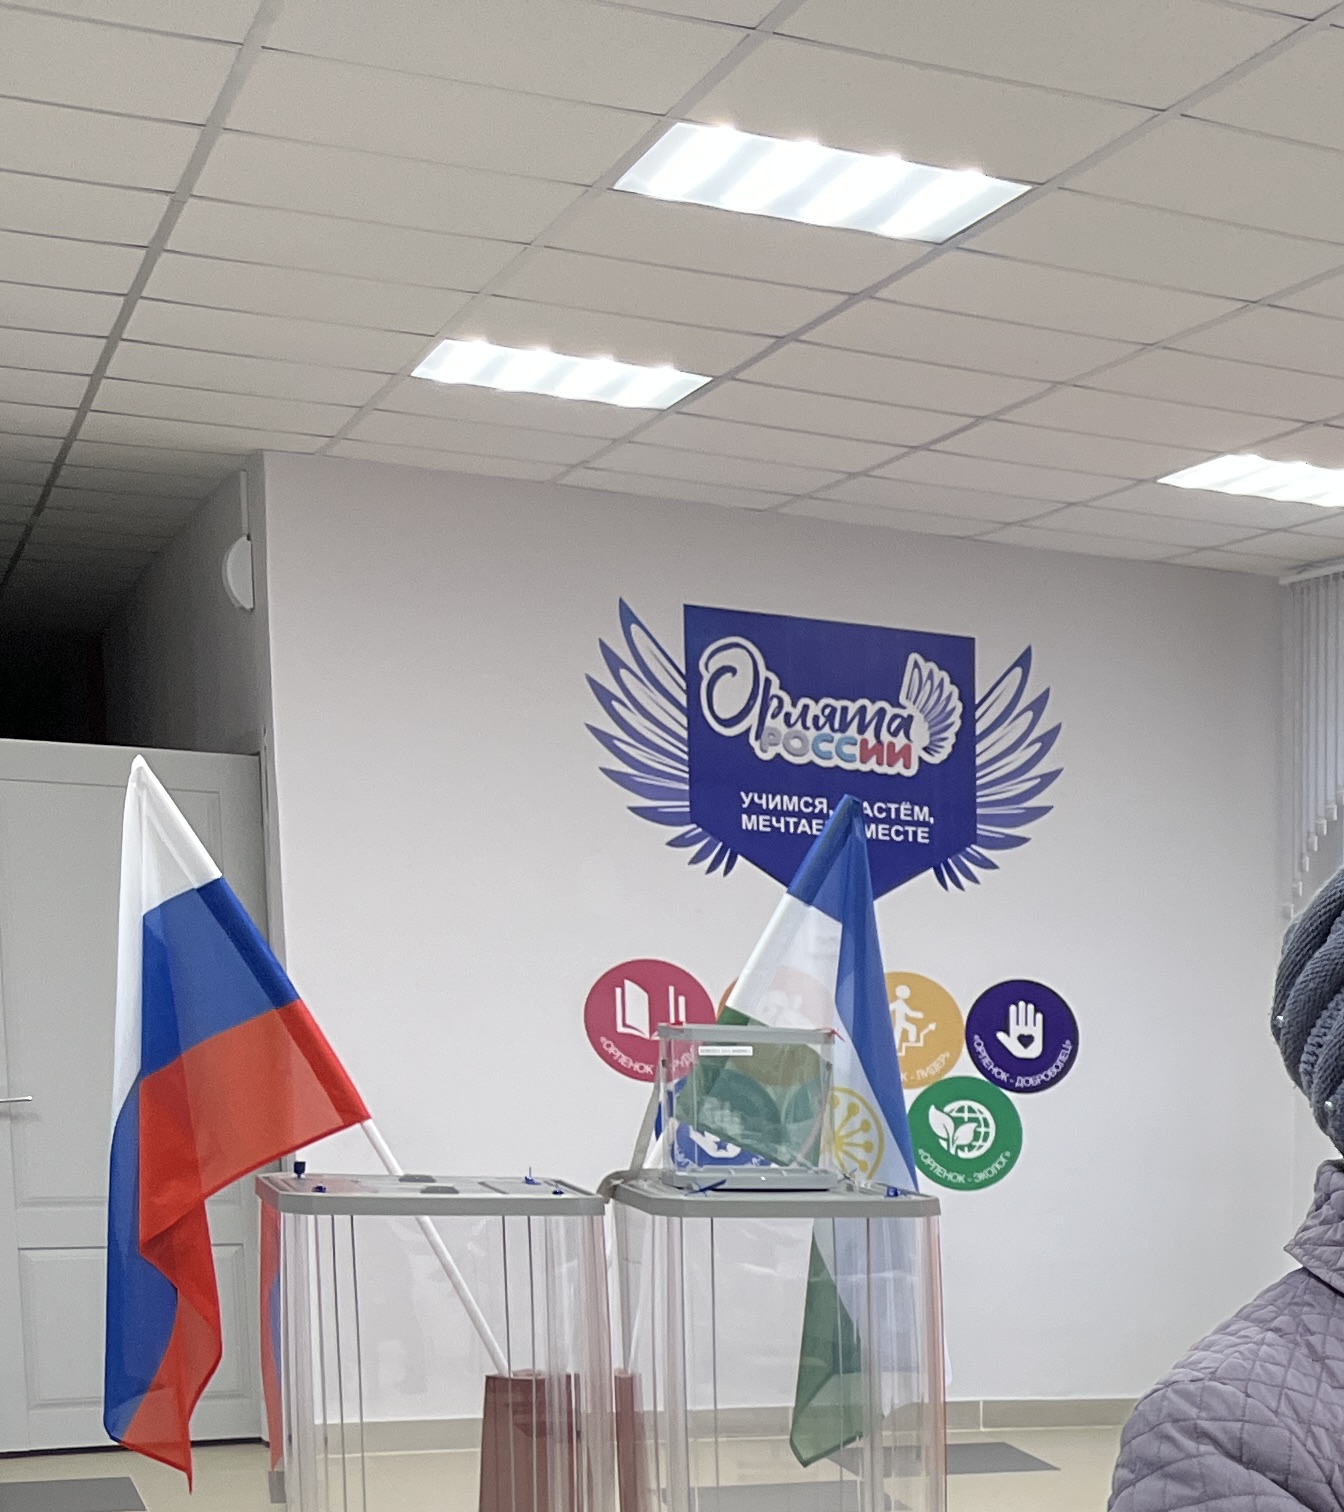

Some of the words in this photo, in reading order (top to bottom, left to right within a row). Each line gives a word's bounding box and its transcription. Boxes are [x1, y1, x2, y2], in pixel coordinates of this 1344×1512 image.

[704, 642, 914, 743] Орлята
[760, 726, 912, 770] РОССИИ
[741, 814, 824, 836] МЕЧТАЕ
[865, 824, 930, 844] МЕСТЕ
[862, 801, 935, 825] АСТЁМ,
